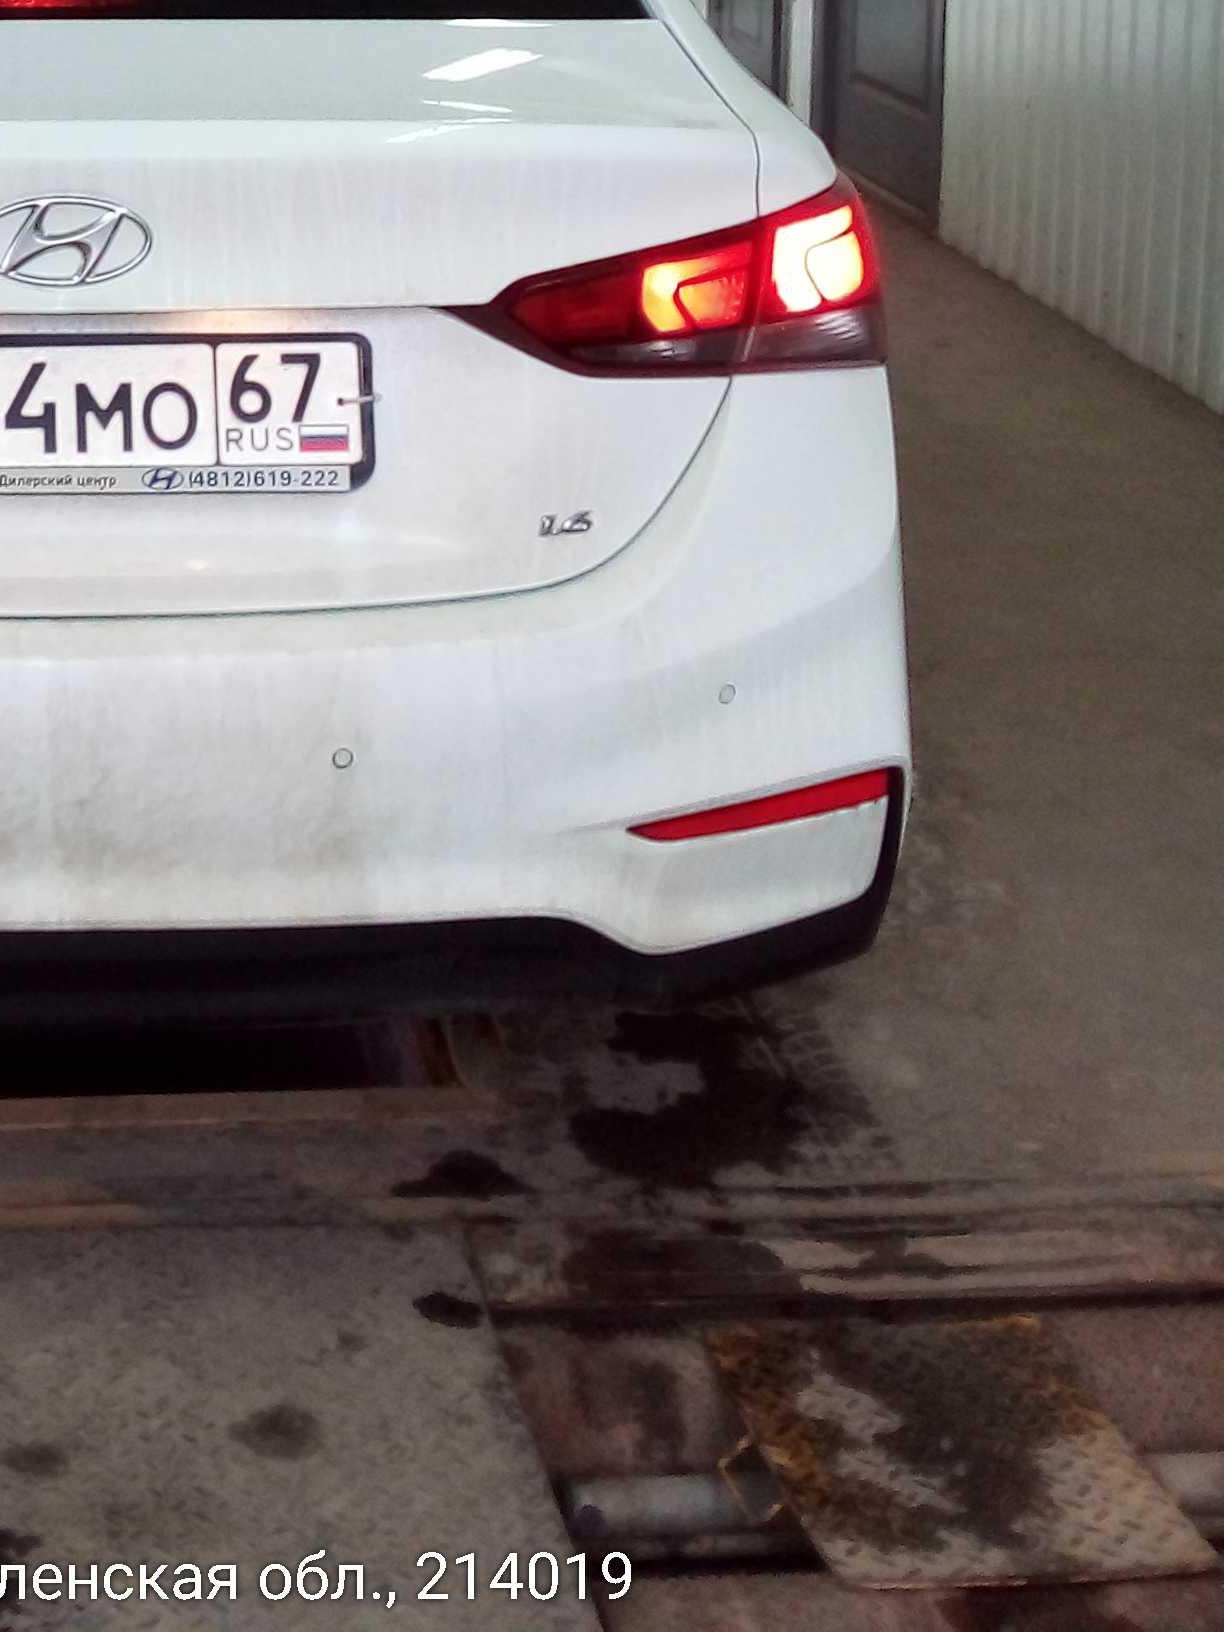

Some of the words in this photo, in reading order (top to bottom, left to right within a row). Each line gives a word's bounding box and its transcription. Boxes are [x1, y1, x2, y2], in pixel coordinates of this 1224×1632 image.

[229, 353, 322, 423] 67
[226, 427, 294, 452] RUS
[77, 474, 117, 491] центр
[189, 470, 339, 488] (4812)619-222
